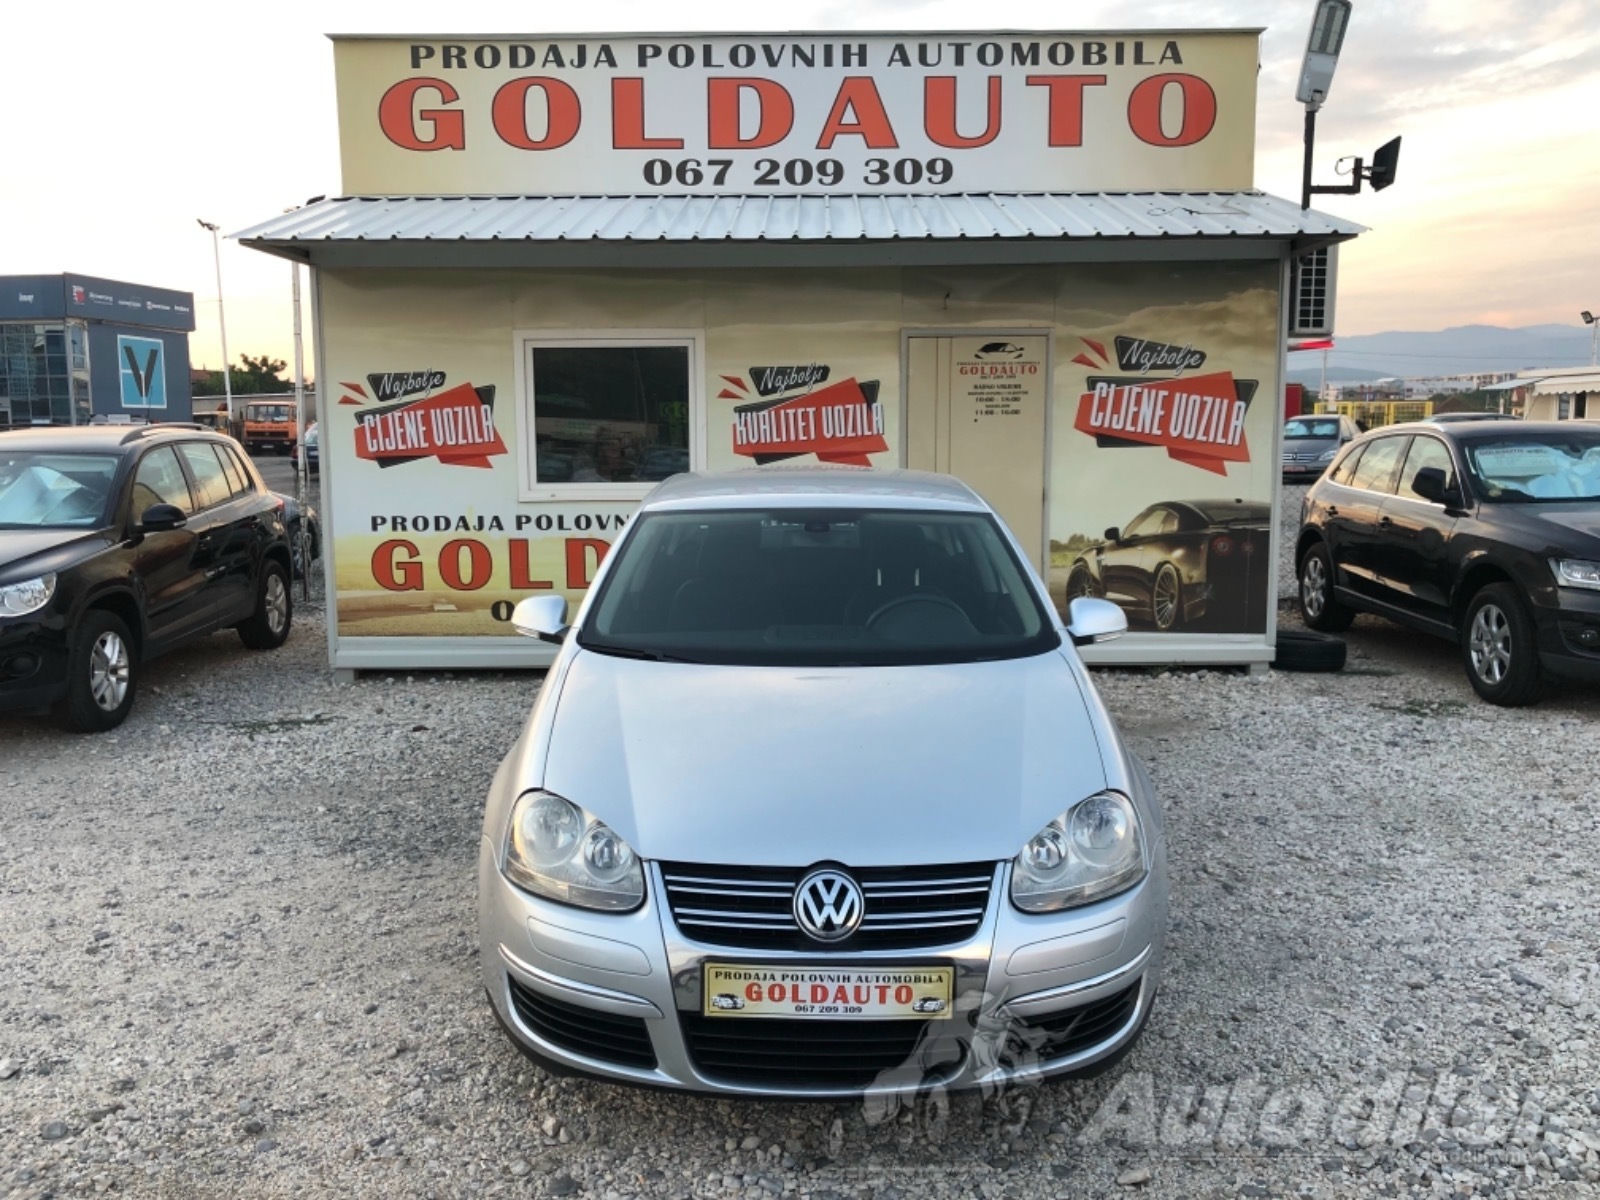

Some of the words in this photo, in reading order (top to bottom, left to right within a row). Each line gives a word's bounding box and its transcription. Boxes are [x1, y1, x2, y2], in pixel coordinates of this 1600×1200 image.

[410, 43, 618, 70] PRODAJA
[637, 43, 868, 70] POLOVNIH
[887, 40, 1184, 68] AUTOMOBILA
[378, 72, 1218, 152] GOLDAUTO
[642, 158, 734, 187] 067
[753, 157, 845, 187] 209
[862, 157, 954, 186] 309
[959, 365, 1038, 376] GOLDAUTO
[1121, 340, 1203, 376] Najbolje
[378, 368, 442, 401] Najbolje
[363, 410, 429, 453] CIJENE
[430, 404, 495, 447] VOZILA
[735, 406, 817, 446] KVALITET
[821, 402, 885, 440] VOZILA
[1089, 382, 1169, 436] CIJENE
[1169, 392, 1247, 446] VOZILA
[371, 514, 505, 532] PRODAJA
[714, 970, 777, 982] PRODAJA
[781, 973, 851, 984] POLOVNIH
[856, 974, 944, 984] AUTOMOBILA
[744, 982, 914, 1005] GOLDAUTO
[795, 1004, 816, 1014] 067
[820, 1005, 840, 1014] 209
[842, 1005, 863, 1014] 309
